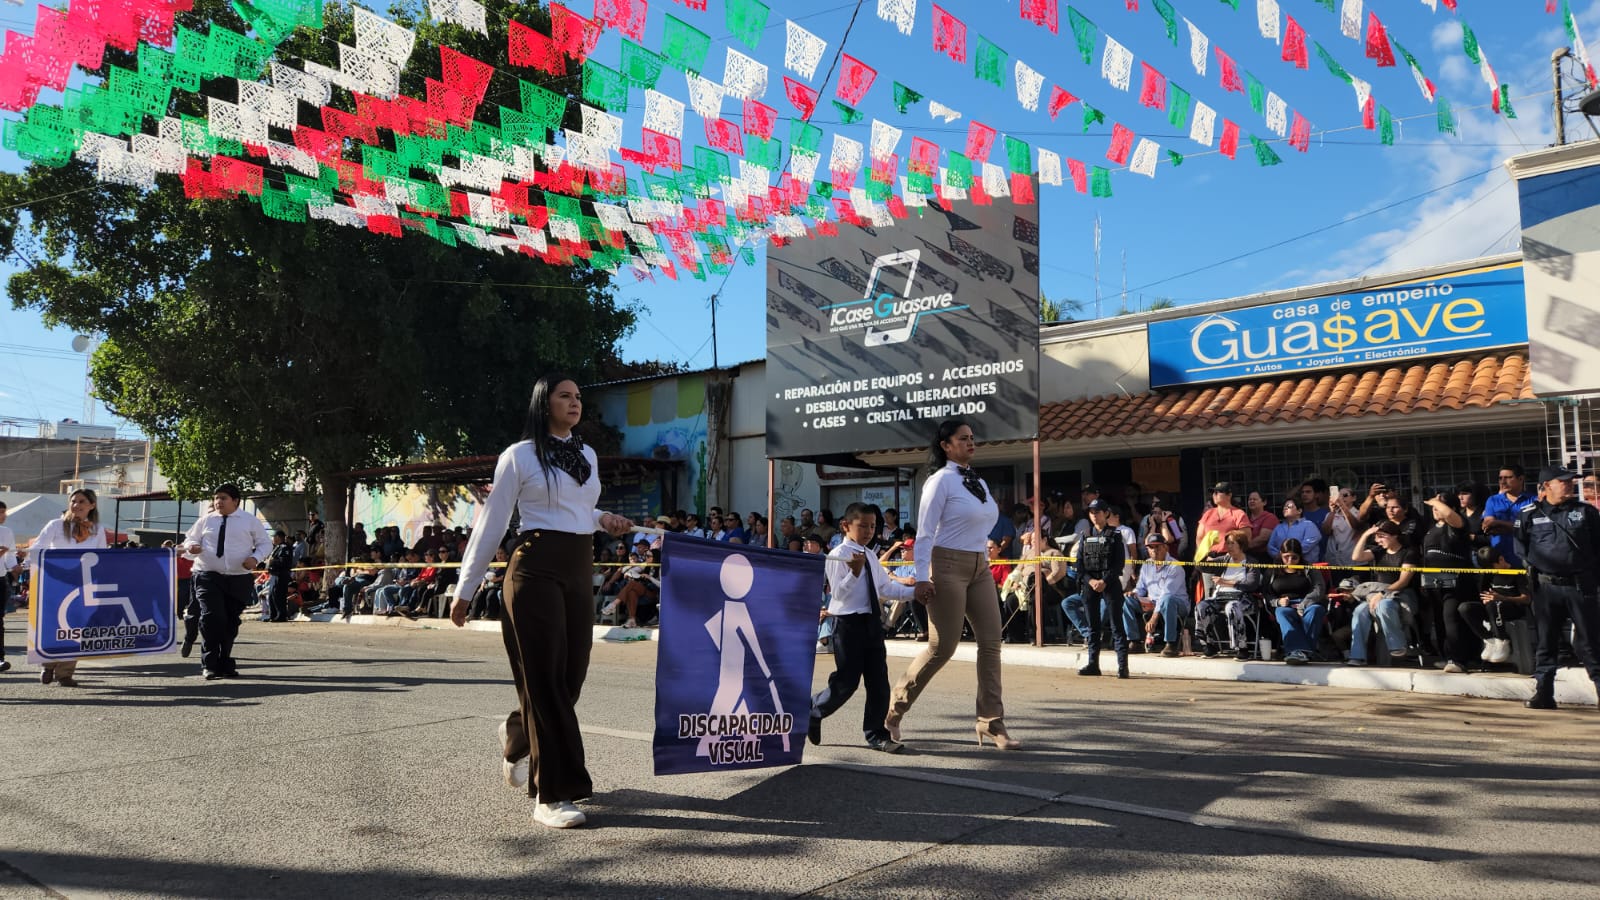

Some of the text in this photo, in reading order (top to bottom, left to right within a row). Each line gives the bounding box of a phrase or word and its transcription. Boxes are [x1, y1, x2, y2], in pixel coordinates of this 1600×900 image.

[1272, 282, 1453, 320] casa de empeño
[1306, 356, 1345, 367] Joyería
[1364, 346, 1427, 360] Electrónica
[942, 359, 1024, 381] ACCESORIOS
[1253, 363, 1283, 373] Autos
[784, 372, 923, 400] REPARACIÓN DE EQUIPOS
[906, 382, 997, 404] LIBERACIONES
[805, 395, 885, 414] DESBLOQUEOS
[866, 401, 986, 424] CRISTAL TEMPLADO
[813, 415, 846, 429] CASES
[57, 623, 159, 641] DISCAPACIDAD
[80, 637, 136, 652] MOTRIZ
[679, 712, 793, 738] DISCAPACIDAD
[708, 740, 763, 765] VISUAL
